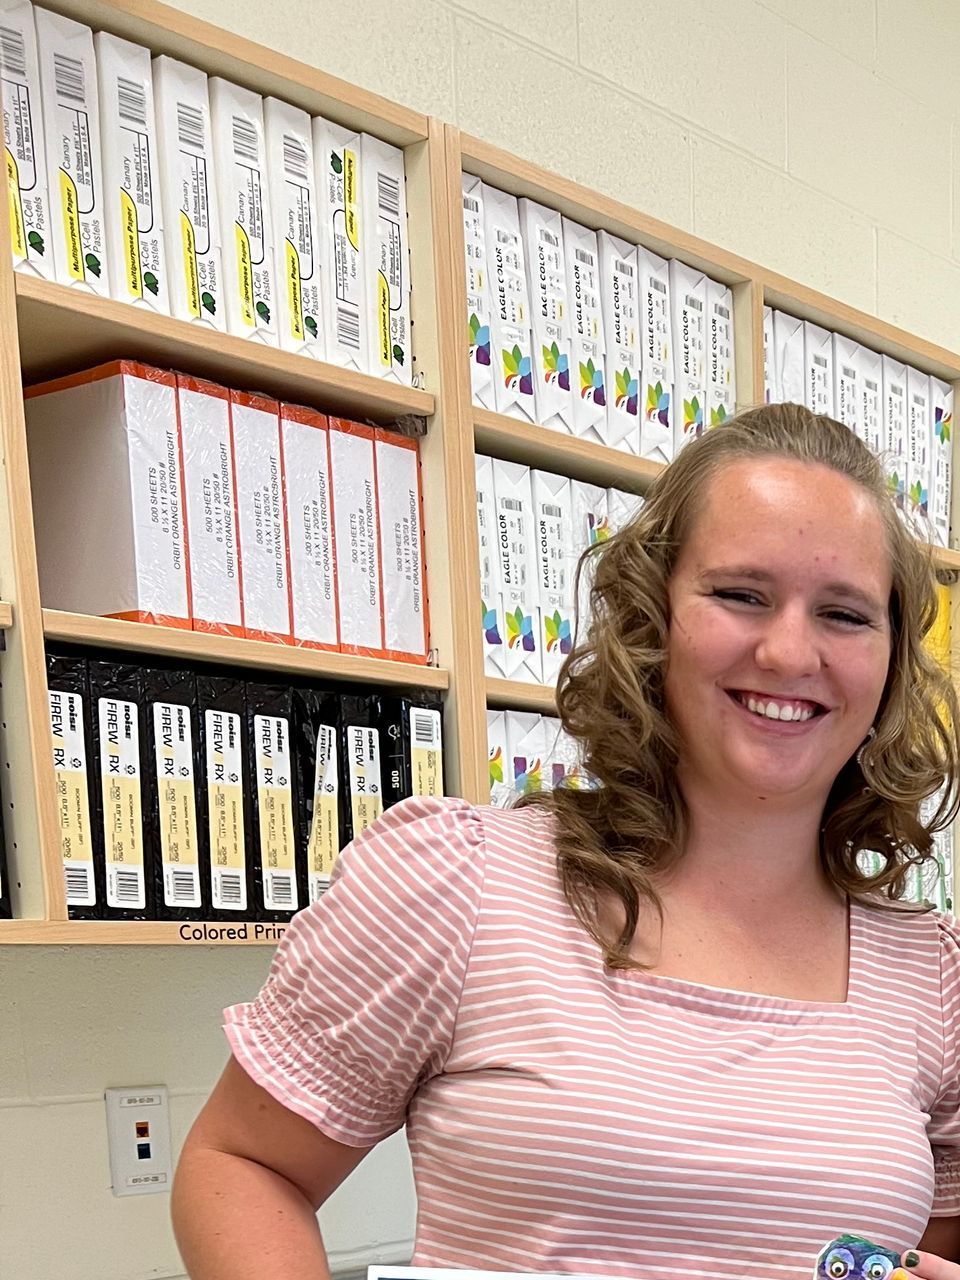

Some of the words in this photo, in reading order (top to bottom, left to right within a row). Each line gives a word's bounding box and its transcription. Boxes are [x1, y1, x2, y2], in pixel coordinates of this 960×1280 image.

[62, 135, 71, 170] Canary
[122, 156, 132, 190] Canary
[182, 180, 190, 212] Canary
[237, 191, 246, 223] Canary
[25, 199, 36, 229] X-Cell
[35, 196, 45, 231] Pastels
[126, 207, 134, 227] Paper
[288, 208, 296, 240] Canary
[68, 208, 80, 273] Multipurpose
[83, 222, 93, 251] X-Cell
[93, 219, 102, 254] Pastels
[127, 227, 139, 291] Multipurpose
[142, 241, 151, 270] X-Cell
[151, 239, 160, 272] Pastels
[496, 247, 504, 283] COLOR
[200, 263, 209, 290] X-Cell
[209, 260, 218, 292] Pastels
[254, 272, 262, 299] X-Cell
[262, 270, 270, 301] Pastels
[574, 265, 582, 300] COLOR
[303, 287, 311, 314] X-Cell
[310, 285, 319, 316] Pastels
[391, 318, 399, 342] X-Cell
[398, 316, 406, 346] Pastels
[576, 302, 584, 335] EAGLE
[166, 430, 178, 497] ASTROBRIGHT
[220, 442, 230, 507] ASTROBRIGHT
[149, 467, 158, 504] SHEETS
[203, 479, 212, 515] SHEETS
[270, 456, 280, 520] ASTROBRIGHT
[319, 470, 328, 534] ASTROBRIGHT
[170, 500, 180, 540] ORANGE
[254, 491, 262, 528] SHEETS
[303, 505, 311, 541] SHEETS
[365, 479, 374, 541] ASTROBRIGHT
[409, 489, 418, 549] ASTROBRIGHT
[224, 510, 233, 548] ORANGE
[273, 521, 282, 559] ORANGE
[499, 514, 508, 549] COLOR
[540, 520, 548, 554] COLOR
[173, 542, 181, 570] ORBIT
[226, 552, 234, 578] ORBIT
[321, 535, 330, 572] ORANGE
[367, 541, 375, 578] ORANGE
[411, 550, 419, 586] ORANGE
[503, 552, 511, 584] EAGLE
[274, 562, 283, 588] ORBIT
[322, 575, 331, 600] ORBIT
[392, 770, 400, 789] 500
[179, 923, 248, 941] Colored
